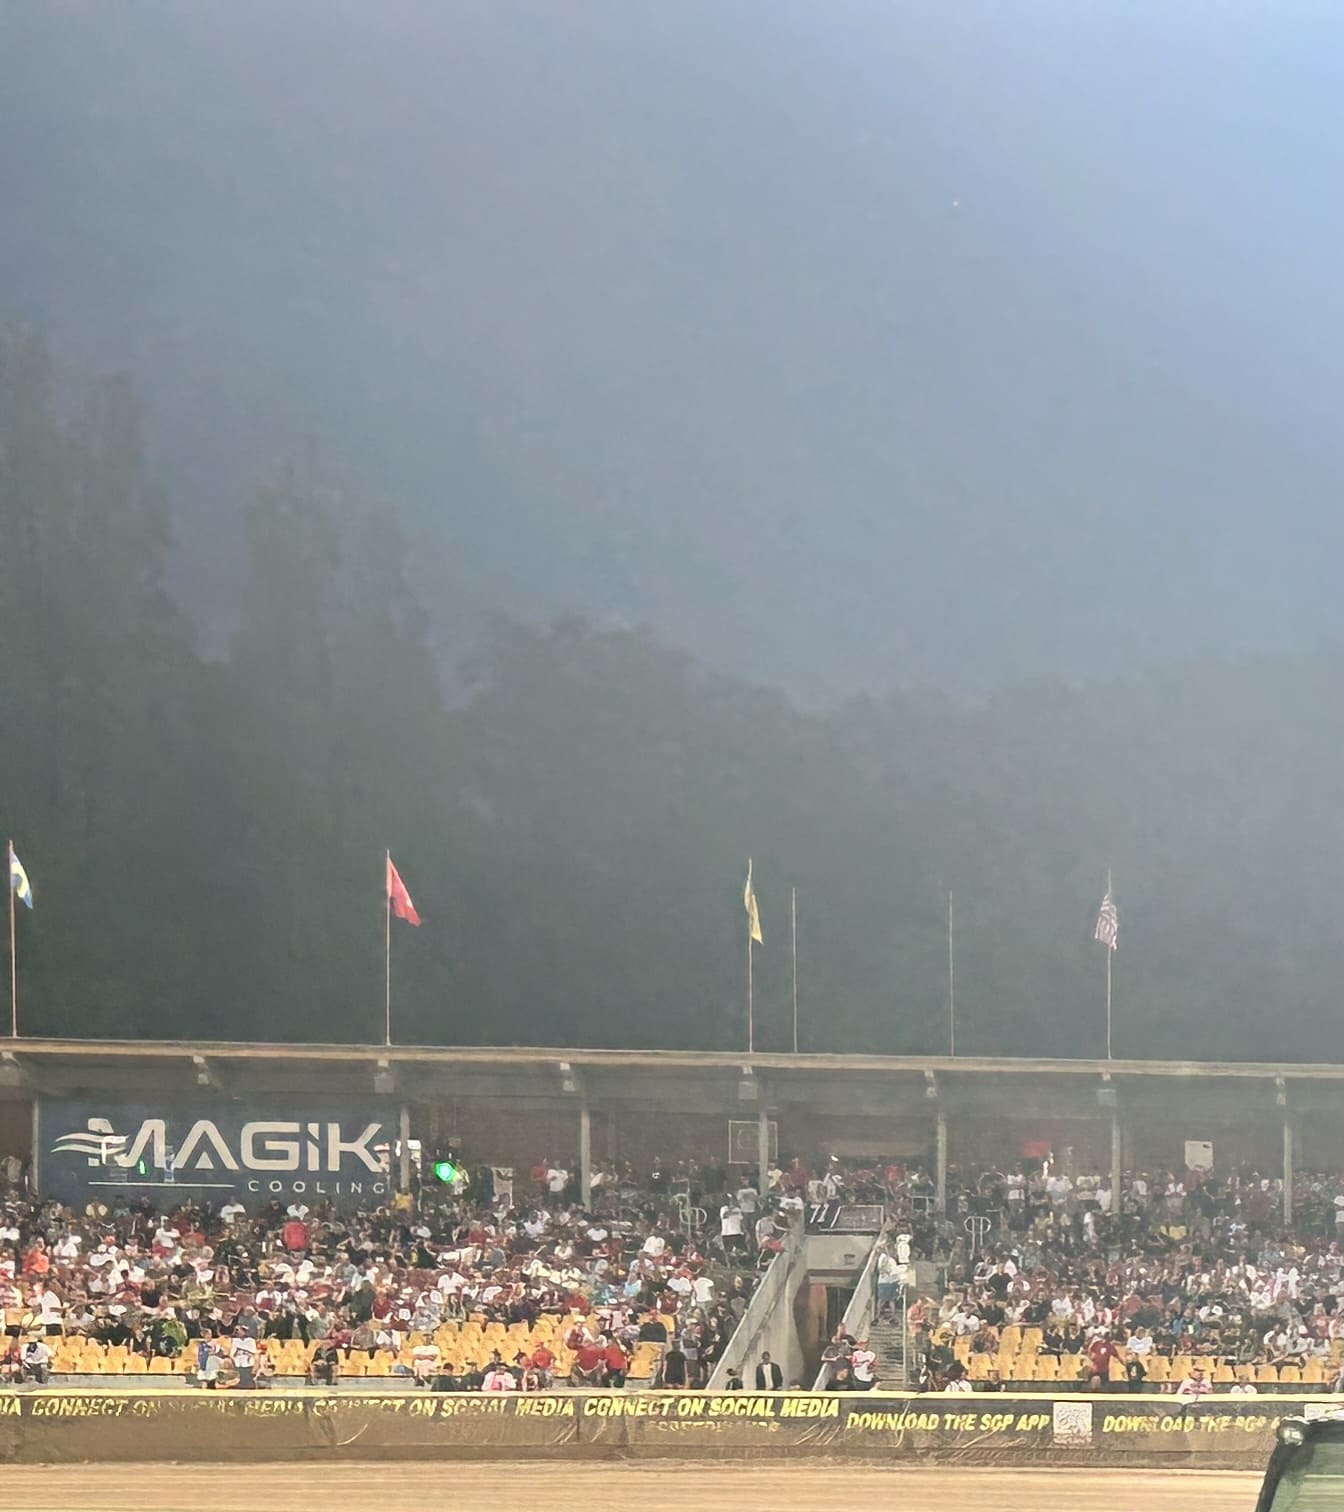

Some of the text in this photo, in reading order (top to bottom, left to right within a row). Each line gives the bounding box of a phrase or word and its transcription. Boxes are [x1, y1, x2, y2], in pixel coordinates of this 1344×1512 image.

[247, 1180, 386, 1195] COOLING
[409, 1399, 437, 1417] ON
[515, 1399, 574, 1417] MEDIA
[584, 1398, 839, 1417] CONNECT ON SOCIAL MEDIA
[847, 1412, 1050, 1431] DOWNLOAD THE SGP APP
